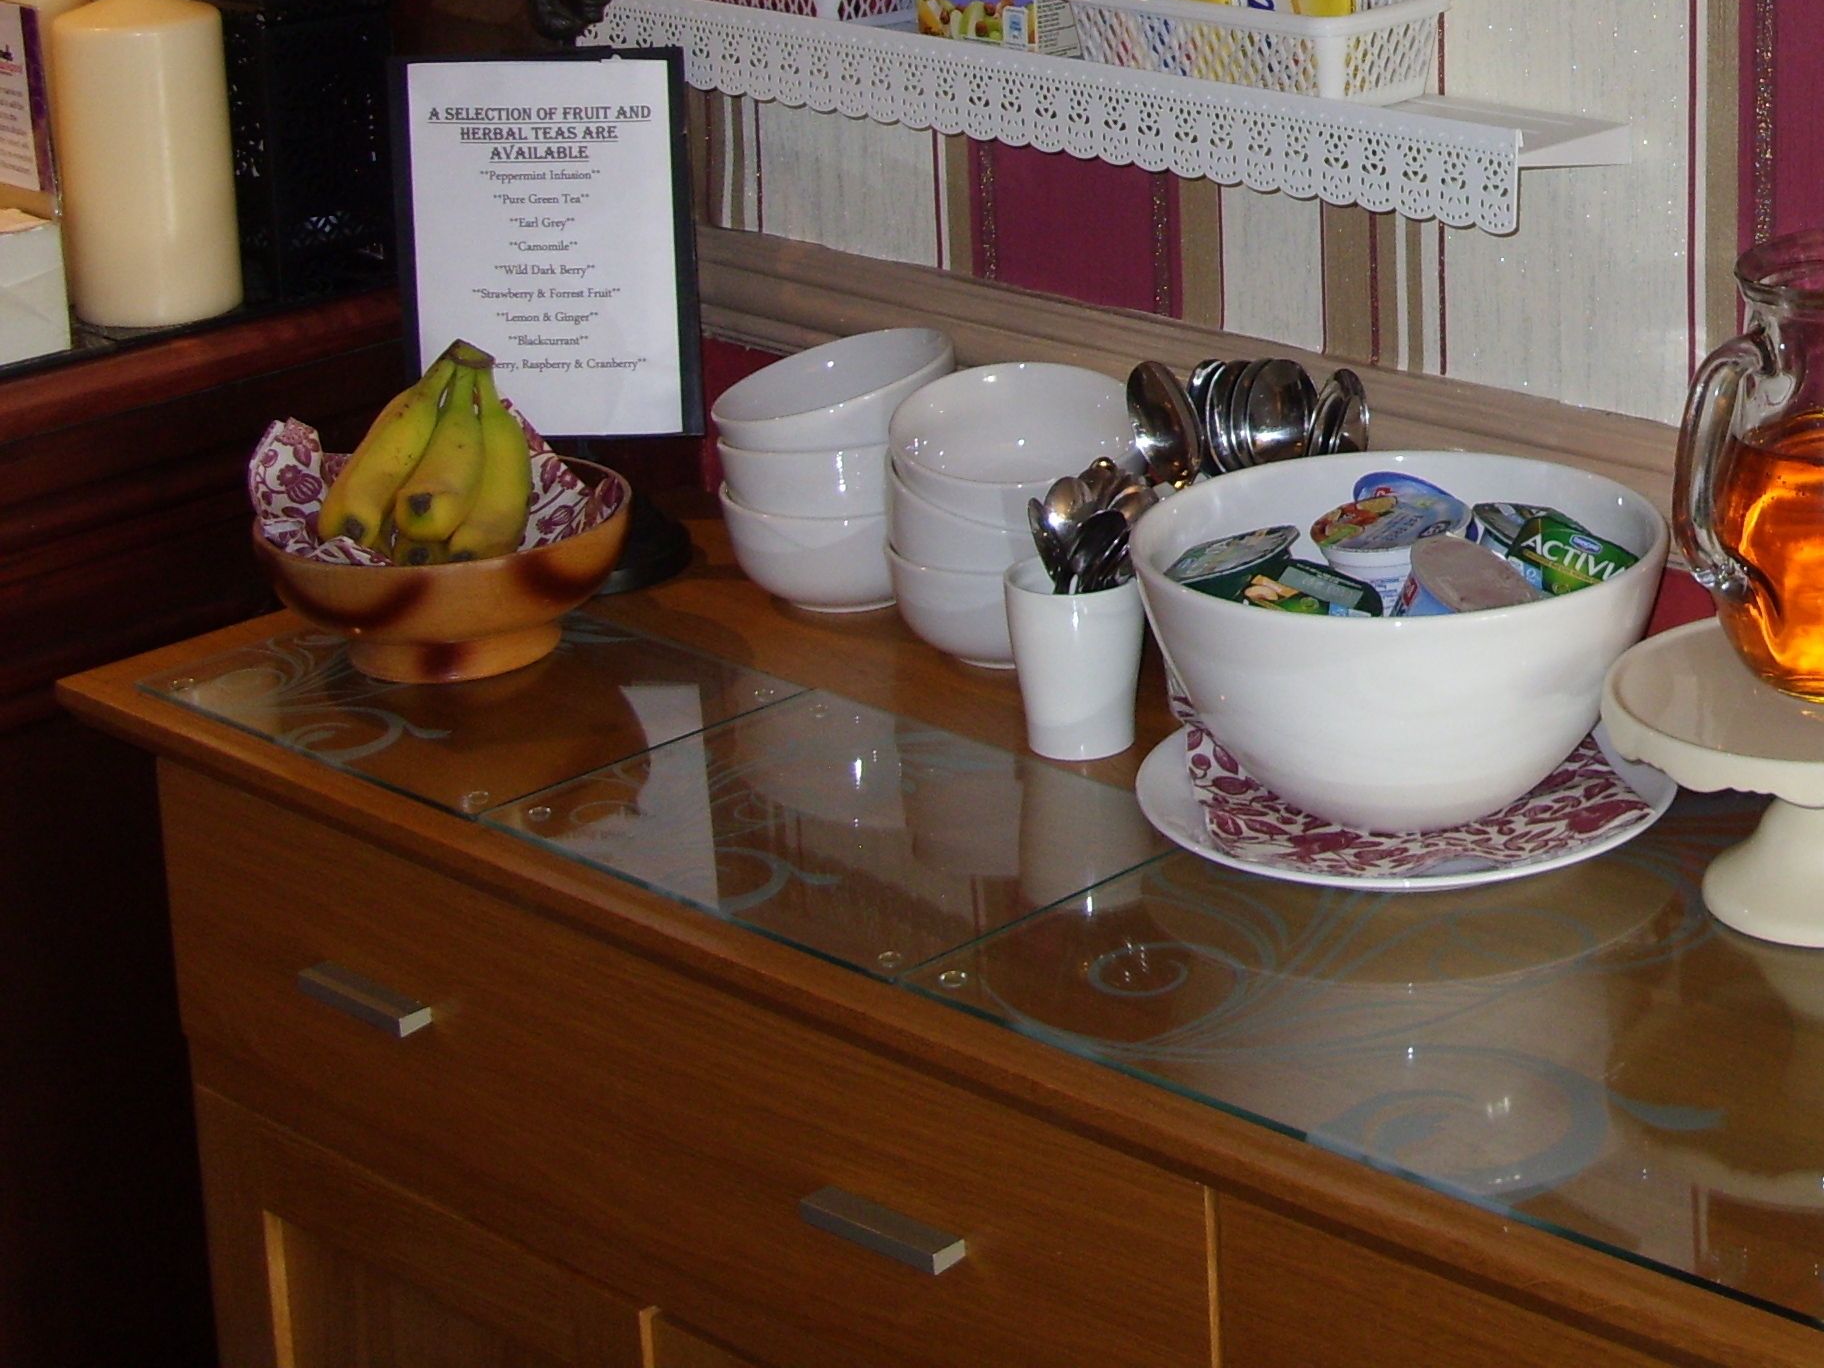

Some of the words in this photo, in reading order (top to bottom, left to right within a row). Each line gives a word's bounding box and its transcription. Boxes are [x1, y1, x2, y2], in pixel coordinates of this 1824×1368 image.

[428, 107, 440, 121] A
[445, 107, 532, 121] SELECTION
[537, 107, 557, 120] OF
[562, 106, 611, 120] FRUIT
[615, 105, 651, 119] AND
[460, 127, 528, 141] HERBAL
[531, 126, 577, 140] TEAS
[582, 126, 618, 139] ARE
[490, 145, 589, 160] AVAILABLE
[528, 193, 559, 204] Green
[531, 264, 556, 275] Dark
[537, 289, 545, 298] &
[550, 288, 584, 298] Forrest
[543, 313, 551, 322] &
[522, 359, 571, 372] Raspberry
[575, 360, 583, 369] &
